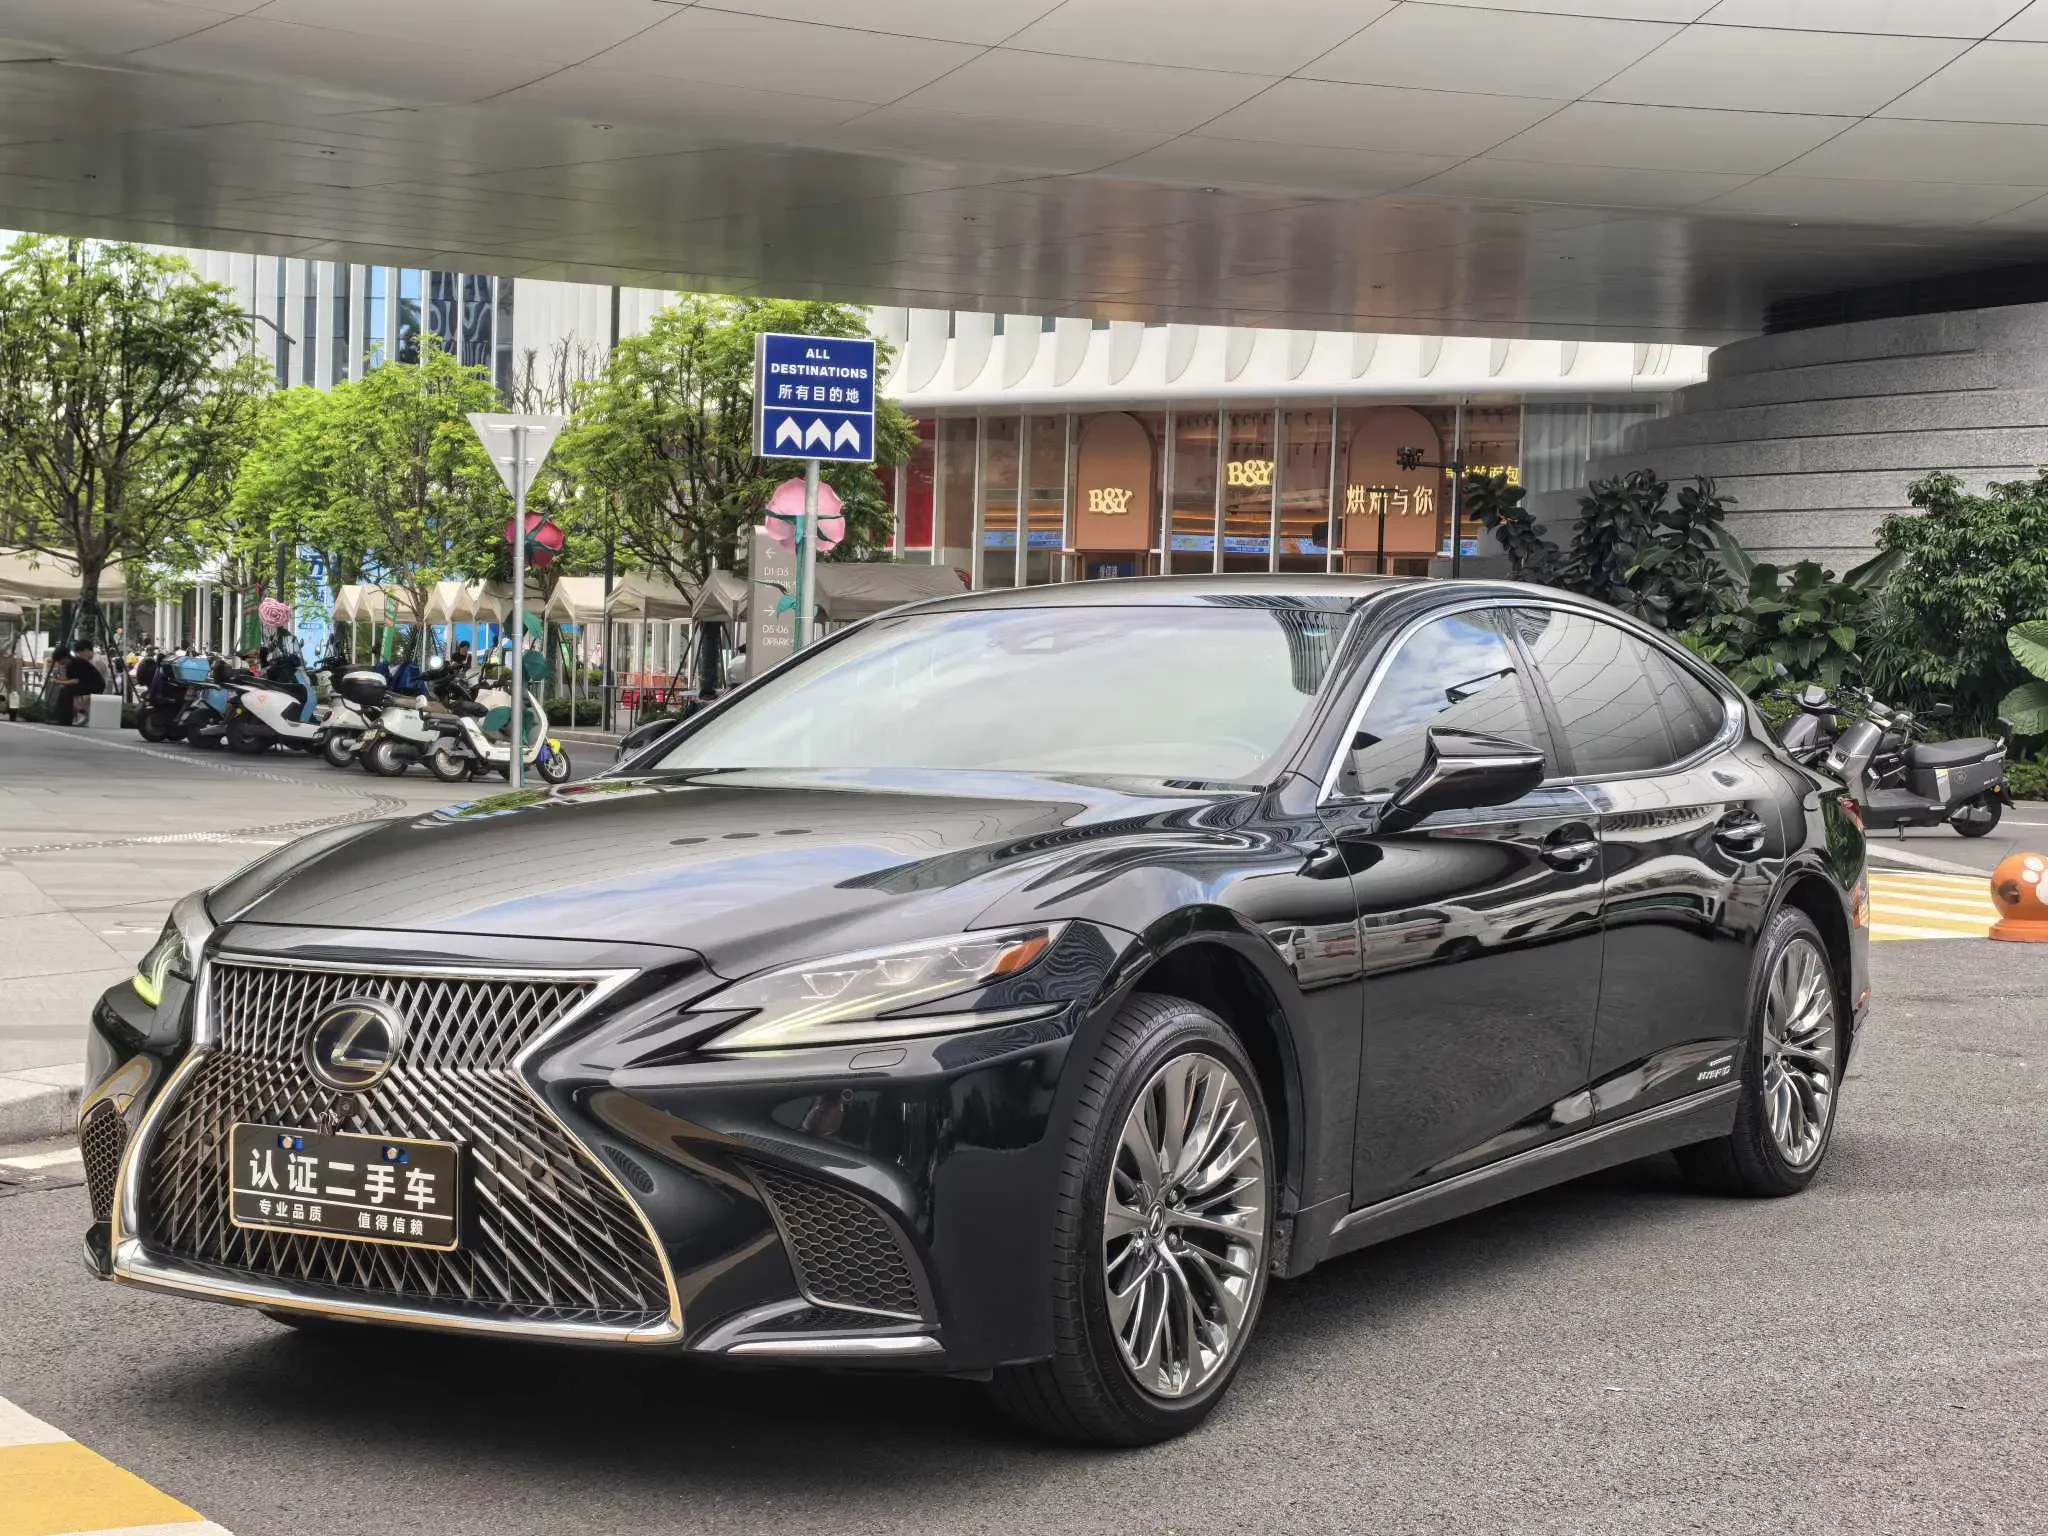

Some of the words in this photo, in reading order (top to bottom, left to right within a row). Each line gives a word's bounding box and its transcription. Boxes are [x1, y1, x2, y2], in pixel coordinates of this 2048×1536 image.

[805, 348, 831, 360] ALL
[771, 362, 868, 379] DESTINATIONS
[778, 384, 860, 403] 所有目的地
[1227, 459, 1274, 487] B&Y
[1088, 487, 1133, 514] B&Y
[249, 1148, 436, 1210] 认证二手车
[258, 1199, 322, 1222] 专业品质
[357, 1211, 424, 1236] 值得信赖
